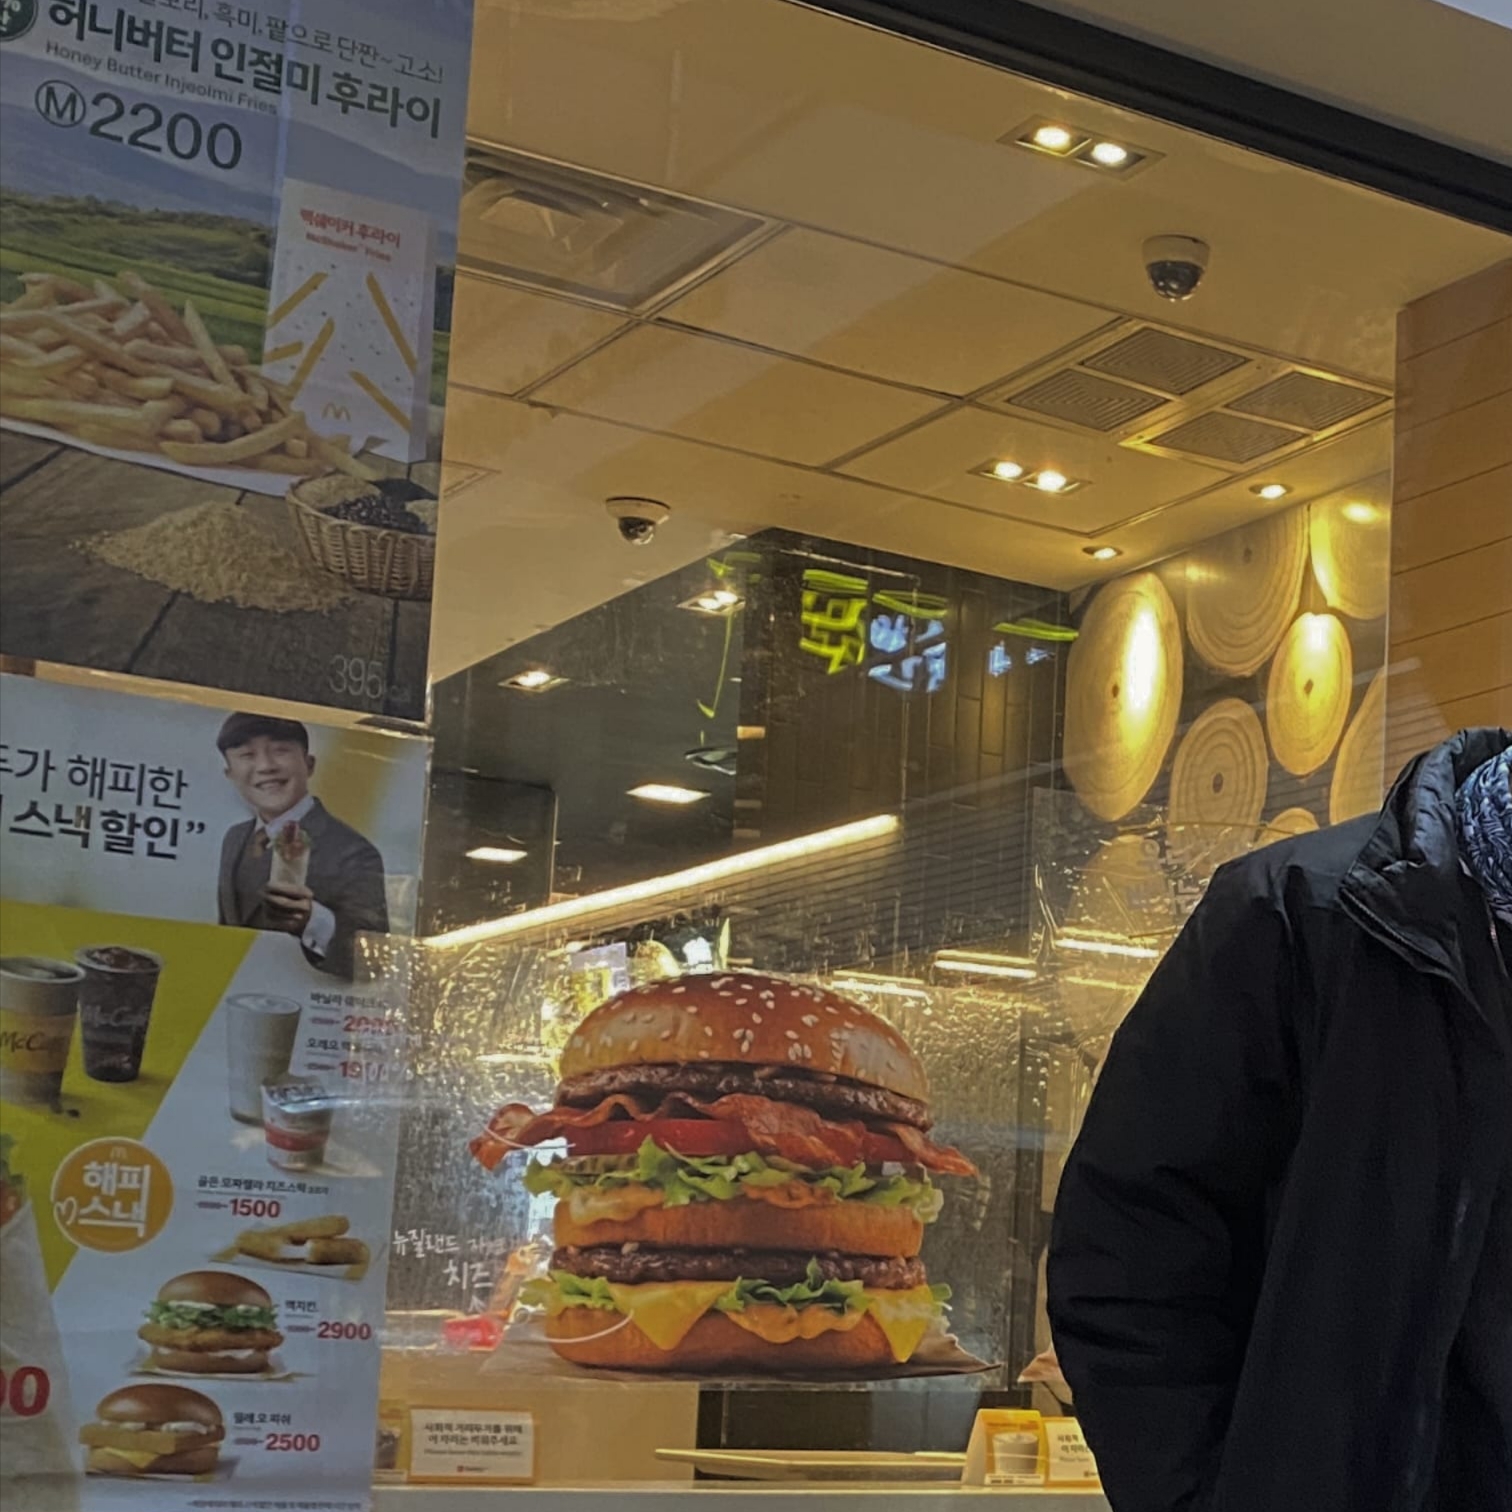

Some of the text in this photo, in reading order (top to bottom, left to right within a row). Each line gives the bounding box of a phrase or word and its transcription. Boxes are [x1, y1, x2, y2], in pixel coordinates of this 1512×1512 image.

[46, 41, 278, 115] Honey Butter Injeolmi Fries
[49, 0, 201, 72] 허니버터
[210, 38, 321, 105] 인절미
[327, 71, 440, 138] 후라이
[89, 92, 242, 169] 2200
[67, 754, 189, 810] 해피한
[8, 800, 93, 849] 스낵
[83, 1161, 152, 1197] 해피
[230, 1198, 282, 1218] 1500
[392, 1227, 460, 1258] 뉴질랜드
[442, 1259, 494, 1290] 치즈
[318, 1321, 372, 1340] 2900
[0, 1365, 51, 1416] 0
[265, 1433, 321, 1452] 2500
